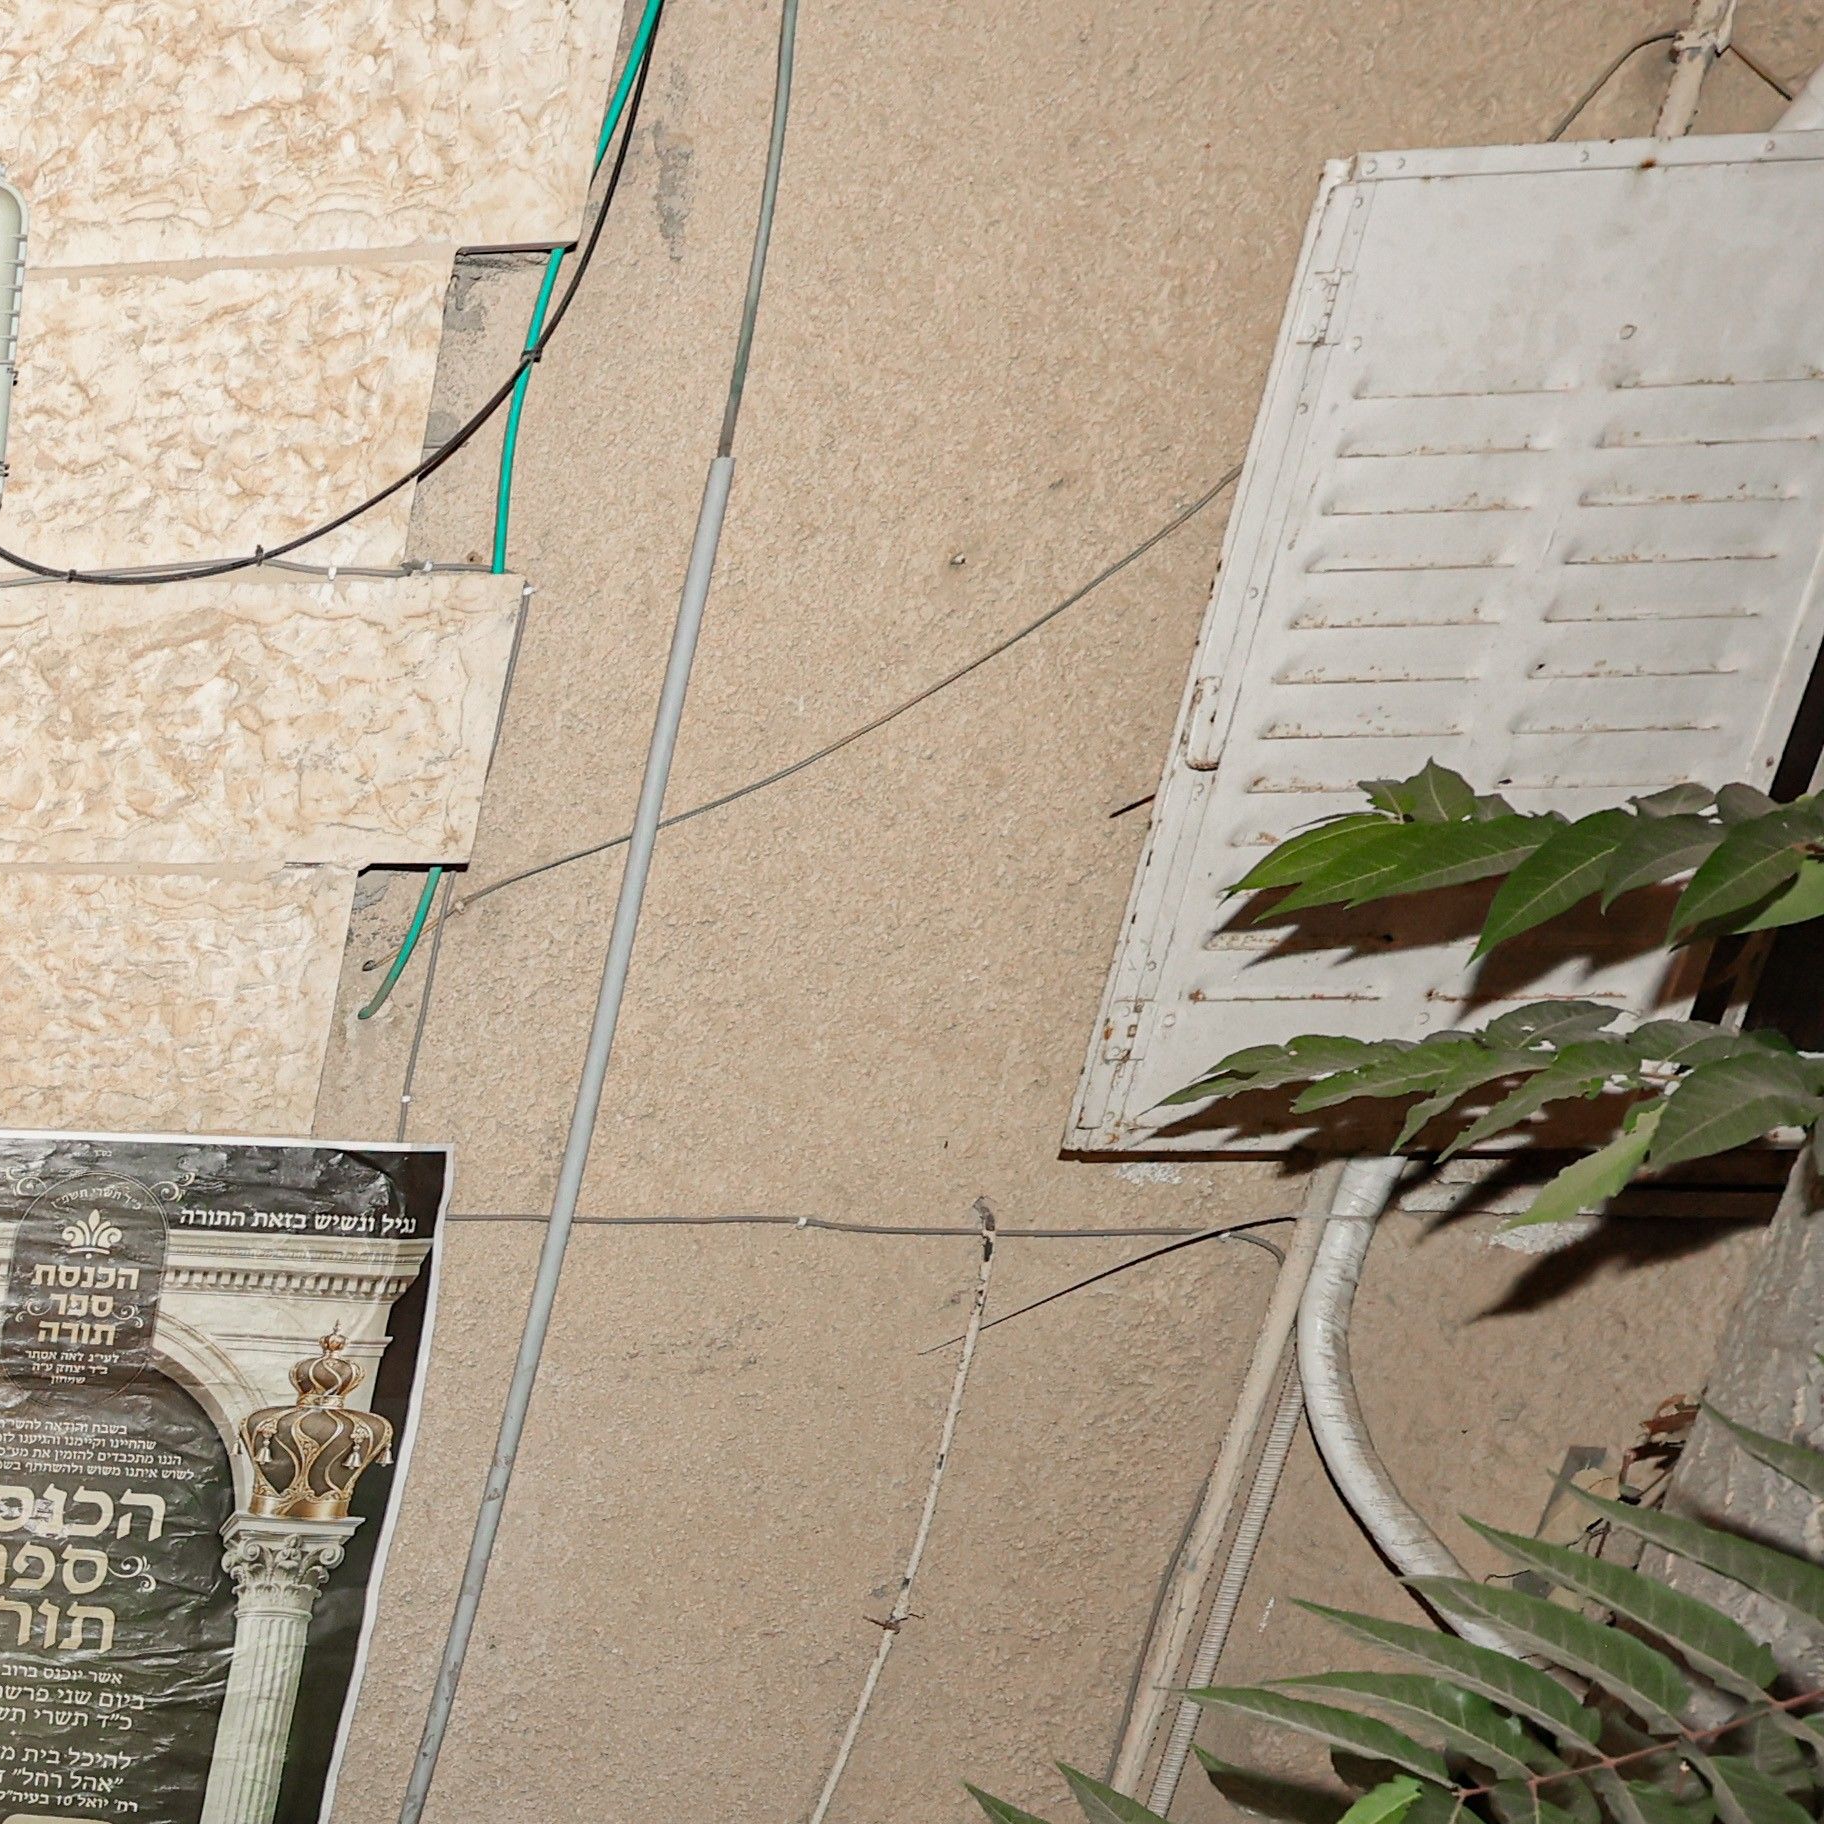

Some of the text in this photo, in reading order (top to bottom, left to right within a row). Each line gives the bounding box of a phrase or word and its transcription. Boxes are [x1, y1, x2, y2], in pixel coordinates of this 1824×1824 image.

[92, 1187, 121, 1200] תשרי
[180, 1208, 416, 1234] נגיל ונשיש בזאת התורה
[30, 1263, 140, 1290] הכנסת
[49, 1293, 114, 1318] ספר
[38, 1320, 116, 1346] תורה
[25, 1350, 57, 1360] אסתר
[60, 1351, 85, 1362] לאה
[56, 1364, 85, 1374] יצחק
[51, 1375, 86, 1384] שמחון
[44, 1421, 128, 1435] בשבח והודאה
[19, 1432, 61, 1445] והגיענו
[65, 1436, 105, 1449] וקיימנו
[110, 1438, 157, 1450] שהחיינו
[31, 1448, 51, 1459] את
[55, 1449, 94, 1461] להזמין
[97, 1452, 154, 1464] מתכבדים
[157, 1454, 182, 1466] הננו
[25, 1461, 84, 1474] ולהשתתף
[87, 1465, 121, 1476] משוש
[125, 1466, 158, 1478] איתנו
[161, 1468, 194, 1480] לשוש
[2, 1664, 38, 1678] ברוב
[42, 1668, 84, 1682] יוכנס
[88, 1671, 123, 1685] אשר
[57, 1688, 93, 1705] שני
[98, 1692, 145, 1710] ביום
[33, 1707, 89, 1727] תשרי
[96, 1713, 133, 1730] כ"ד
[22, 1748, 61, 1764] בית
[67, 1747, 132, 1770] להיכל
[57, 1794, 72, 1806] 10
[77, 1794, 109, 1808] יואל
